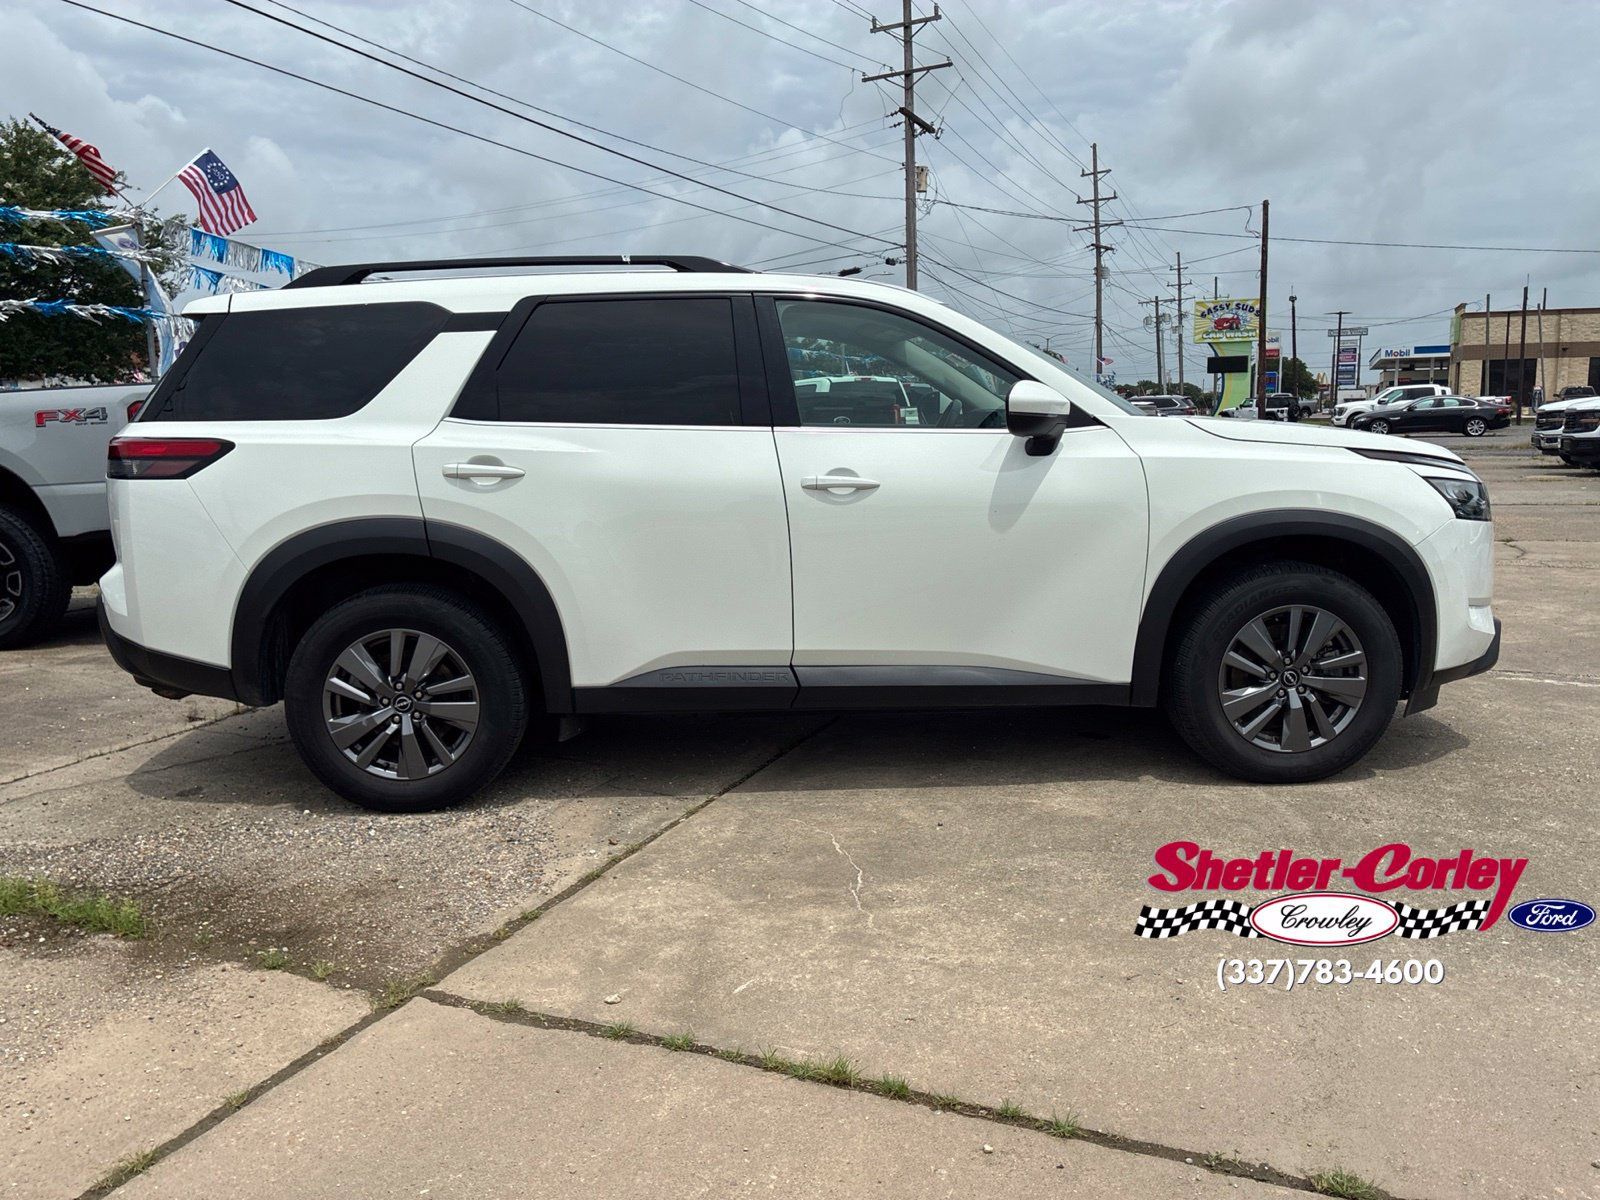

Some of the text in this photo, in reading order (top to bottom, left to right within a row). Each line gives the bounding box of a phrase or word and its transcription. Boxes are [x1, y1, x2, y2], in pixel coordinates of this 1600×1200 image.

[1200, 302, 1261, 319] SASSY SUDS
[1202, 329, 1257, 339] CAR WASH
[1384, 349, 1411, 358] Mobil
[34, 406, 108, 428] FX4
[659, 671, 790, 682] PATHFINDER
